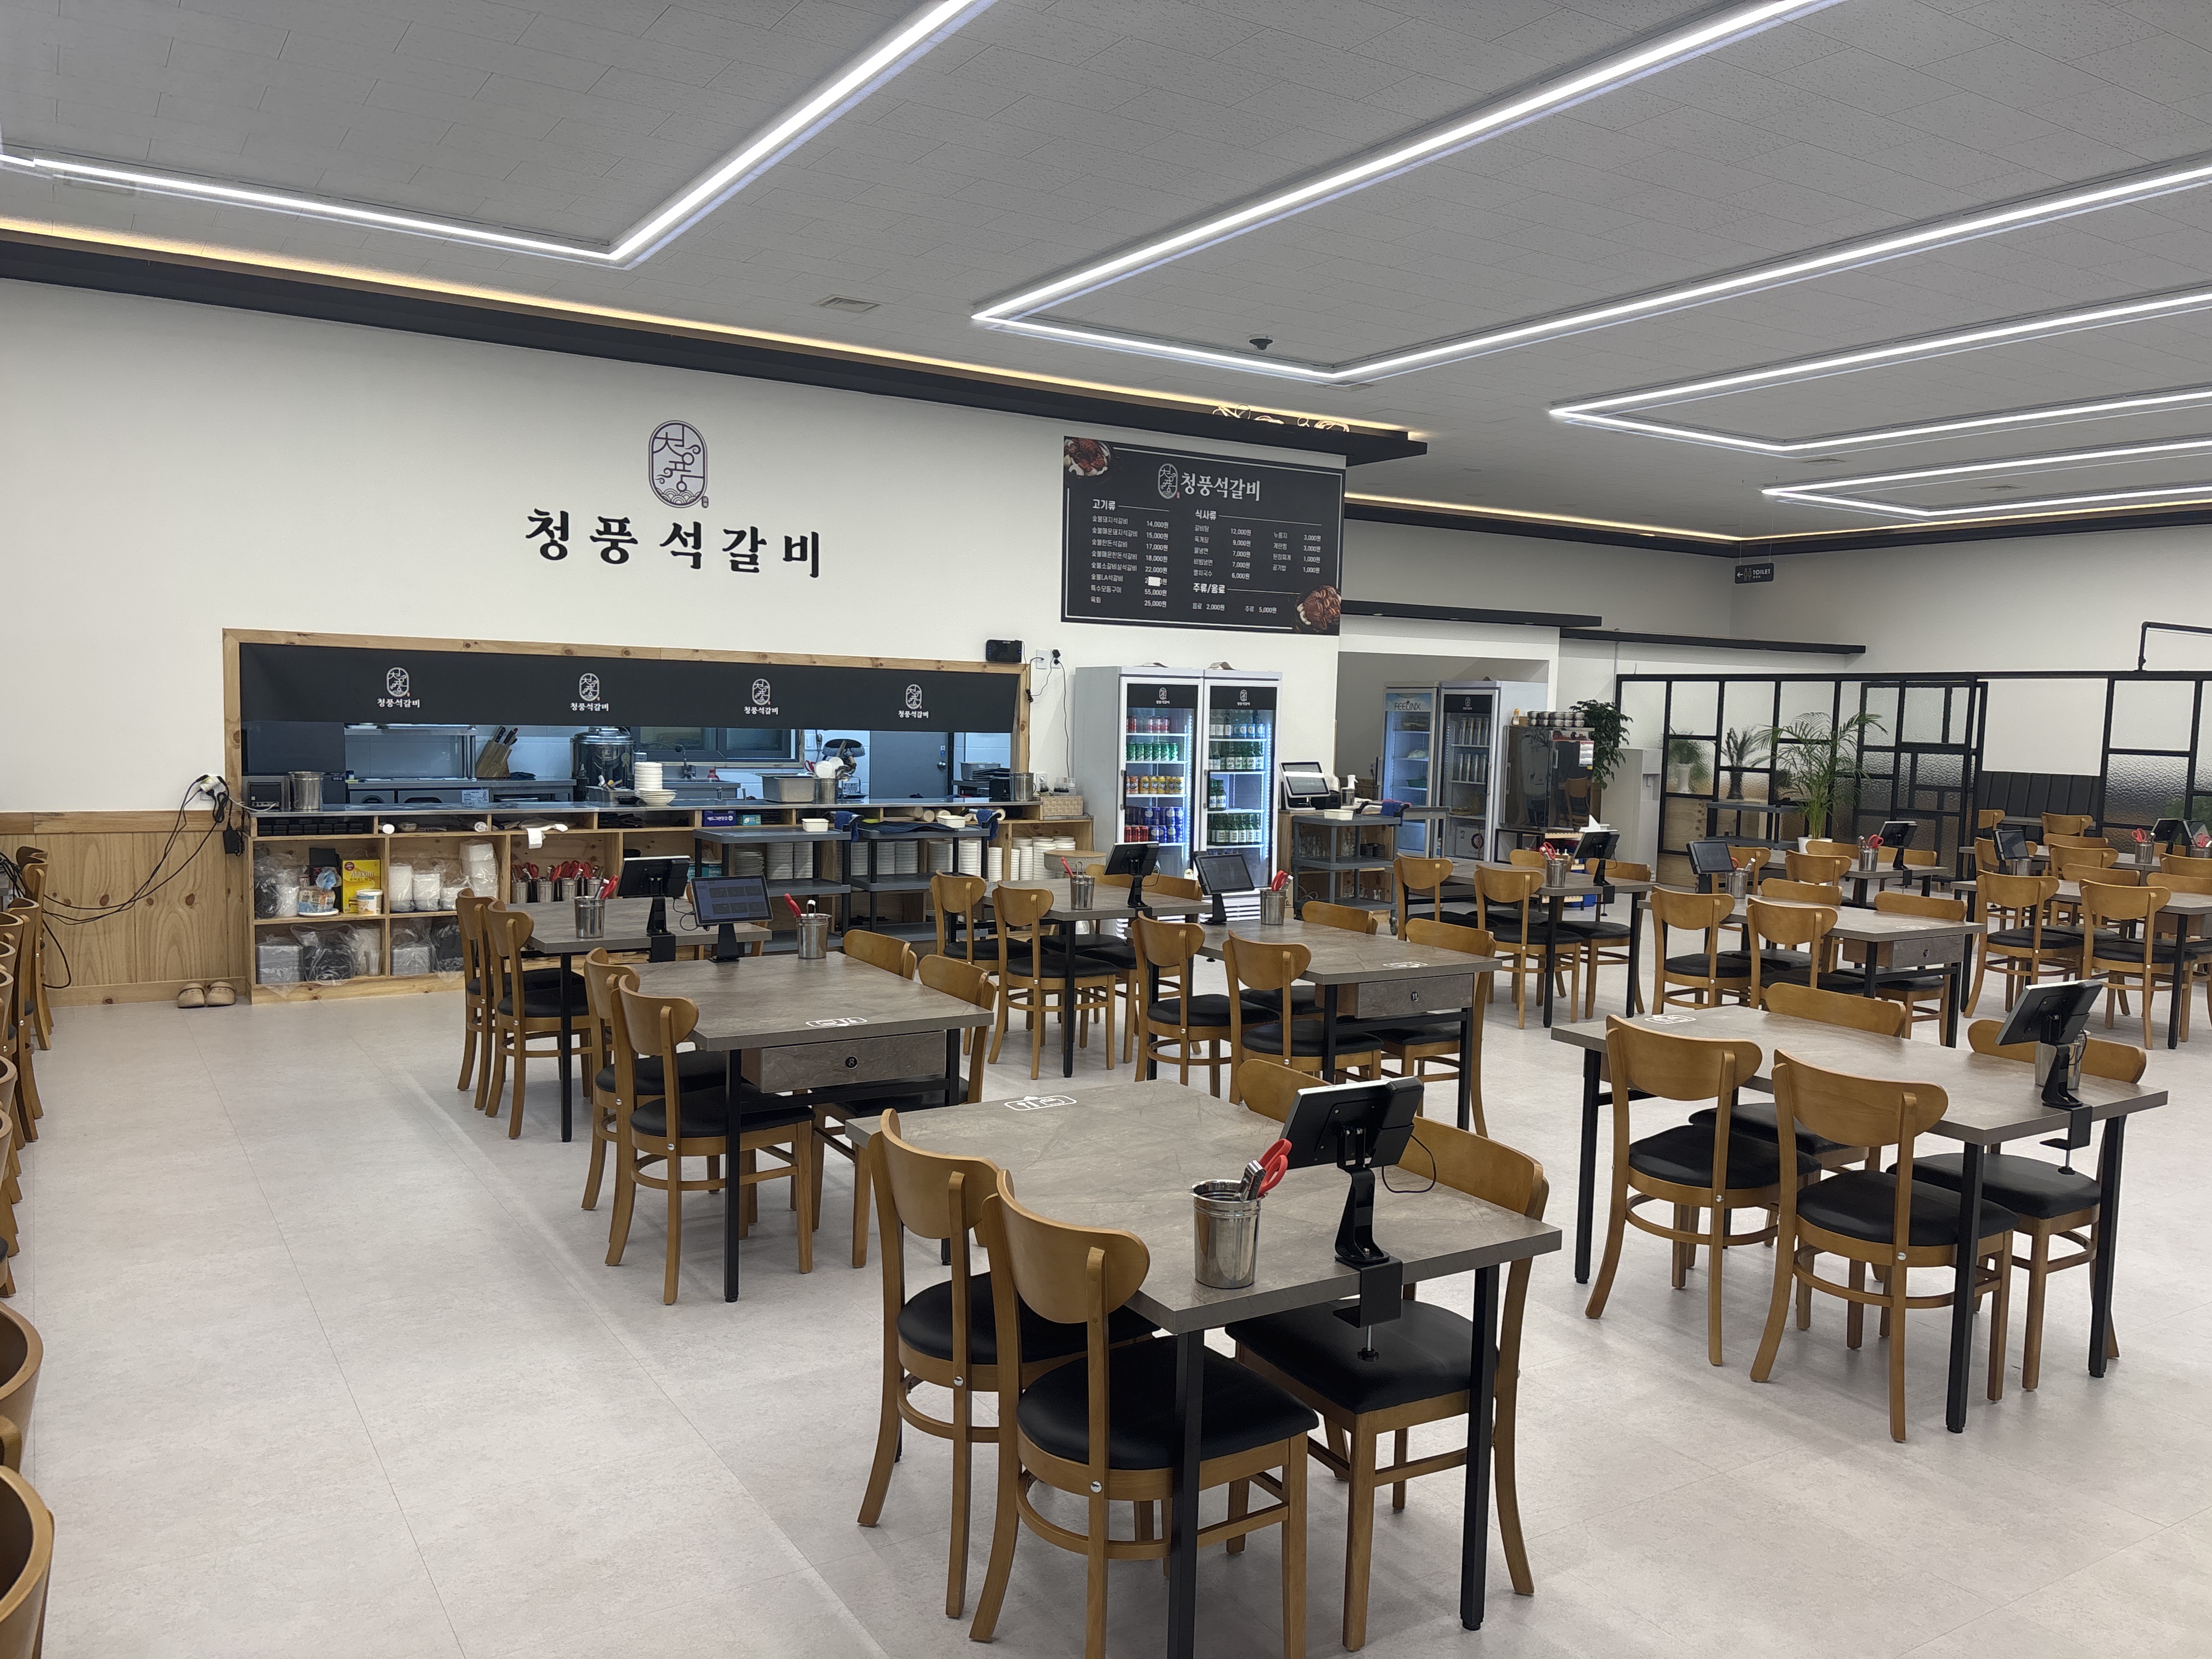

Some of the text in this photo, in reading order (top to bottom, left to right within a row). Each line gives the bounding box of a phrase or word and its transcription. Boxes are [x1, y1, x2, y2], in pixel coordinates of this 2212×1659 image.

[1180, 472, 1260, 501] 청풍석갈비
[1092, 499, 1116, 511] 고기류
[1195, 509, 1217, 521] 식사류
[1147, 520, 1169, 529] 14,000원
[1194, 524, 1251, 536] 갈비탕 12,000원
[1146, 532, 1169, 540] 15,000원
[525, 507, 820, 578] 청풍석갈비
[1146, 543, 1169, 551] 17,000원
[1146, 555, 1168, 563] 18,000원
[1145, 566, 1168, 574] 22,000원
[1144, 588, 1167, 597] 55,000원
[1193, 583, 1226, 594] 주류/음료
[1144, 600, 1167, 608] 25,000원
[377, 698, 420, 708] 청풍석갈비
[570, 702, 609, 712] 청풍석갈비
[743, 706, 778, 715] 청풍석갈비
[898, 710, 929, 719] 청풍석갈비
